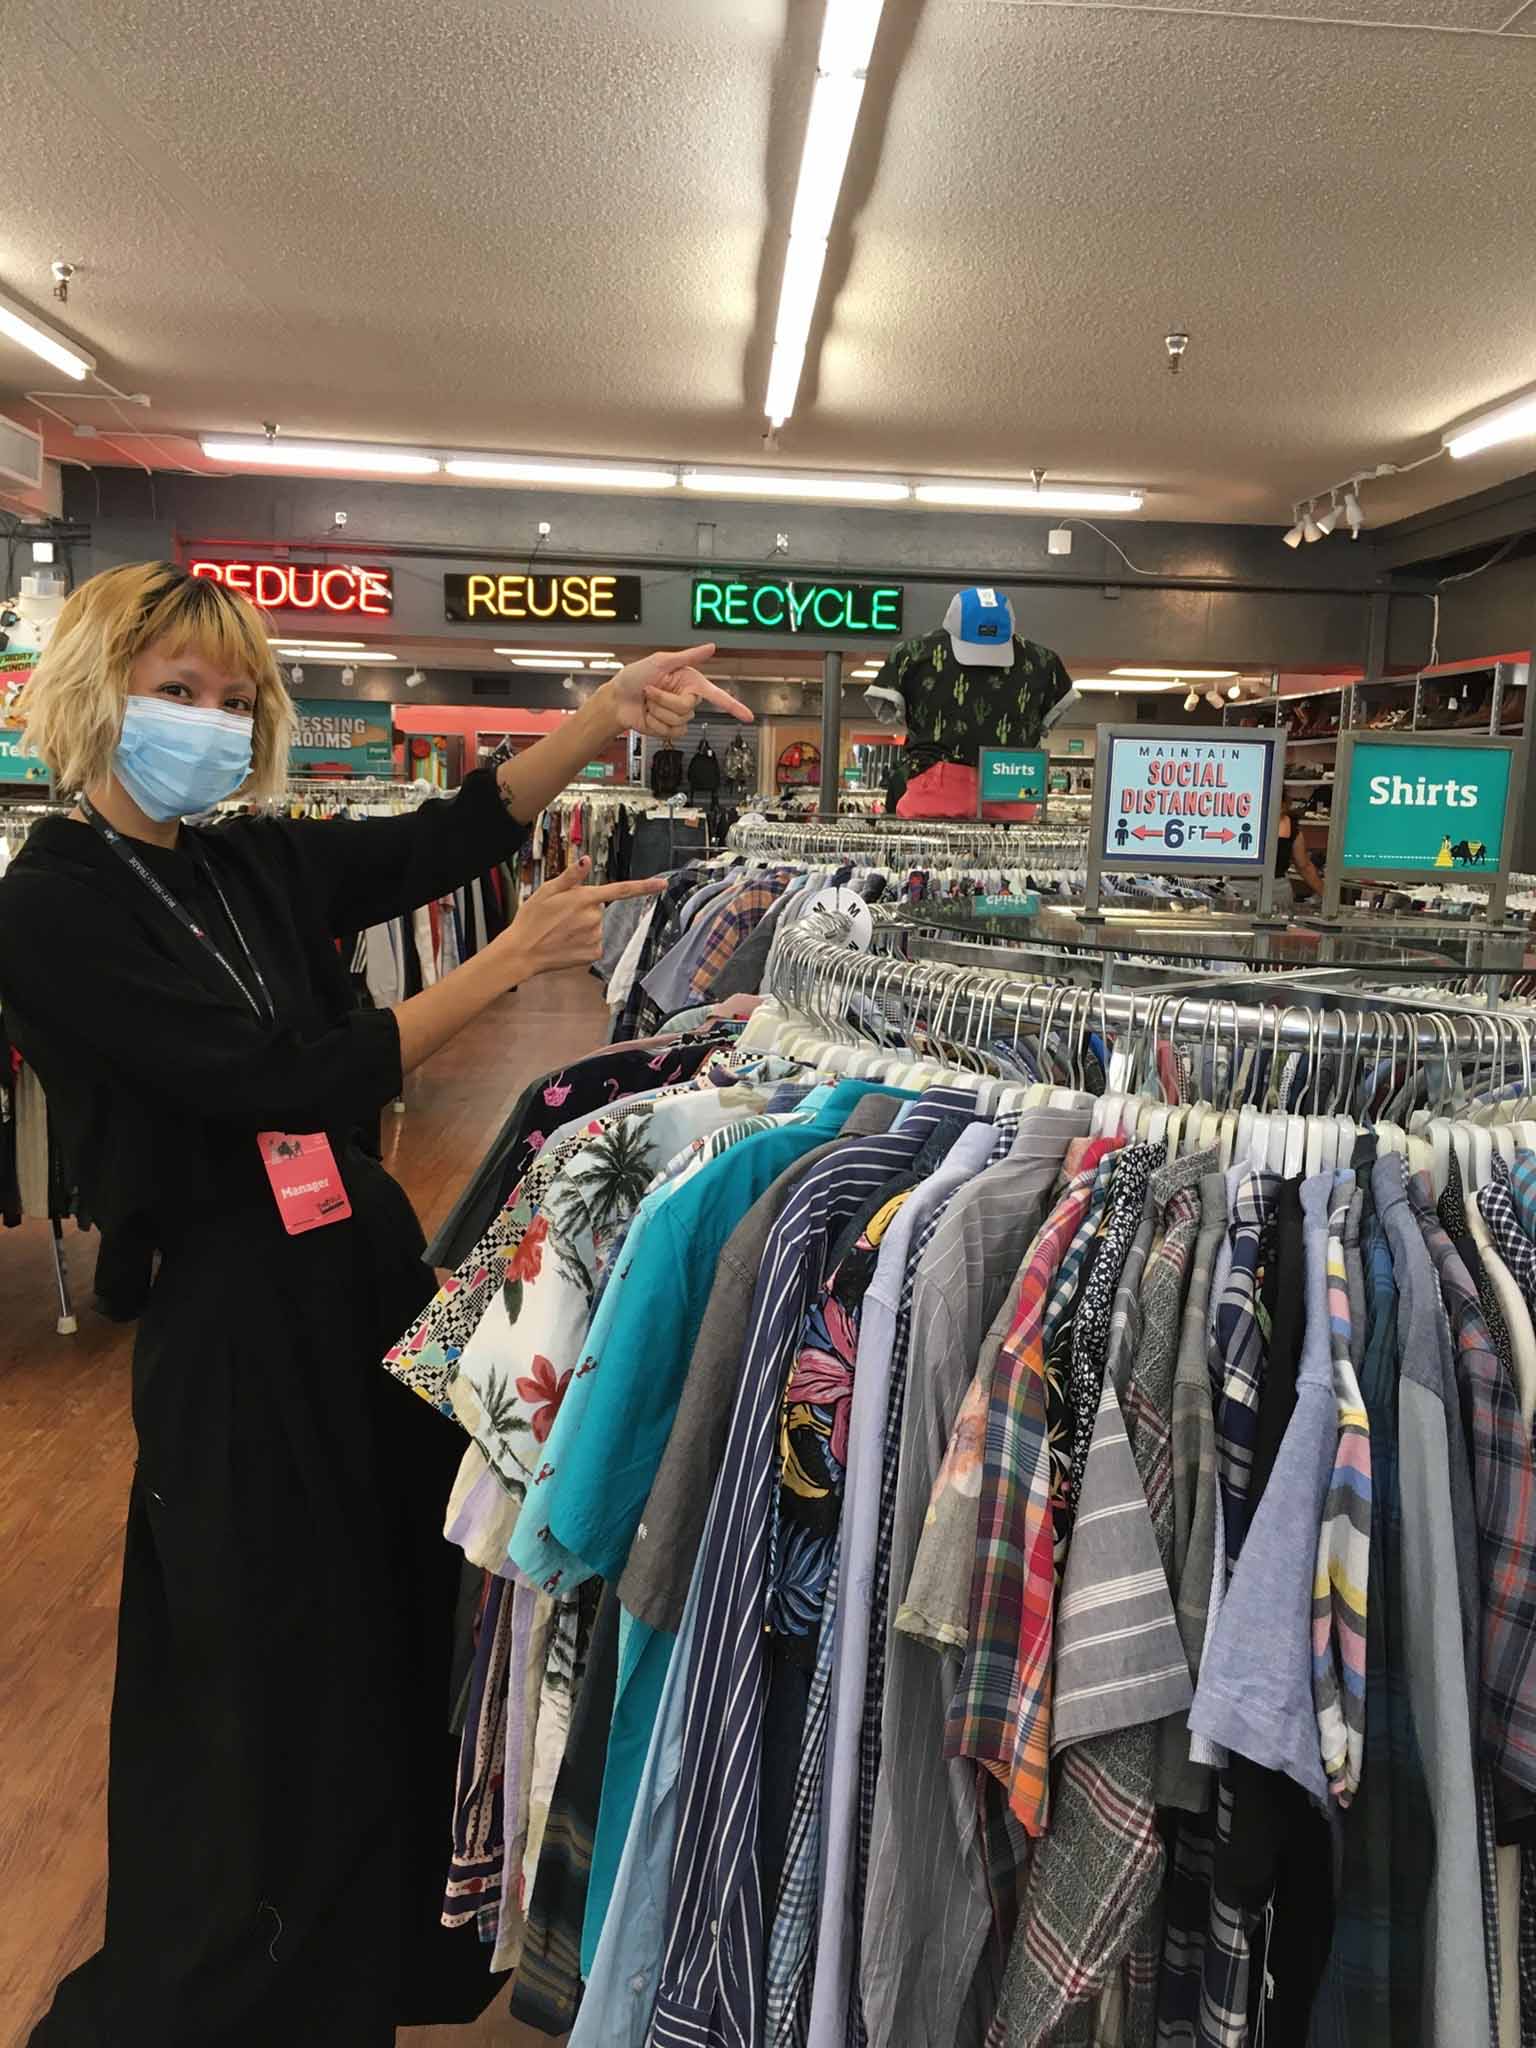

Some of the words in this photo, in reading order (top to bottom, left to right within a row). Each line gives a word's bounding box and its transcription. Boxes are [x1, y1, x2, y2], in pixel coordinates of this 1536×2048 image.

[468, 575, 617, 617] REUSE
[694, 583, 900, 630] RECYCLE
[0, 741, 38, 758] Tes
[291, 731, 352, 749] ROOMS
[1139, 747, 1240, 759] MAINTAIN
[992, 763, 1035, 776] Shirts
[1148, 760, 1228, 788] SOCIAL
[1121, 788, 1252, 817] DISTANCING
[1369, 775, 1478, 807] Shirts
[1164, 819, 1185, 849] 6
[1188, 825, 1208, 841] FT
[848, 902, 861, 918] M
[281, 1178, 329, 1199] Manager
